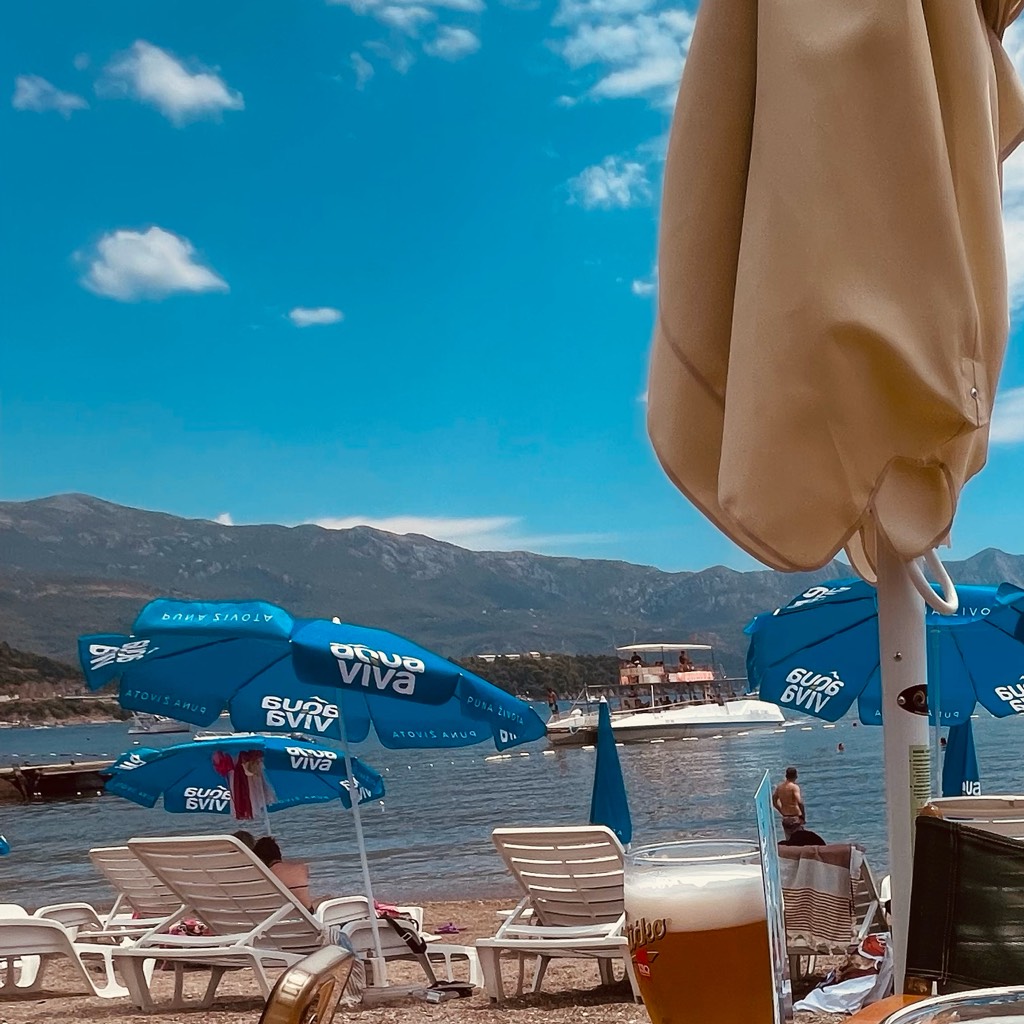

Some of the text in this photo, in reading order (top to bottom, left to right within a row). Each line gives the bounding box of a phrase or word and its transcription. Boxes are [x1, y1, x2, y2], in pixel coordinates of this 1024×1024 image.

[330, 642, 425, 673] aqua
[337, 659, 416, 695] viva
[290, 756, 333, 771] viva
